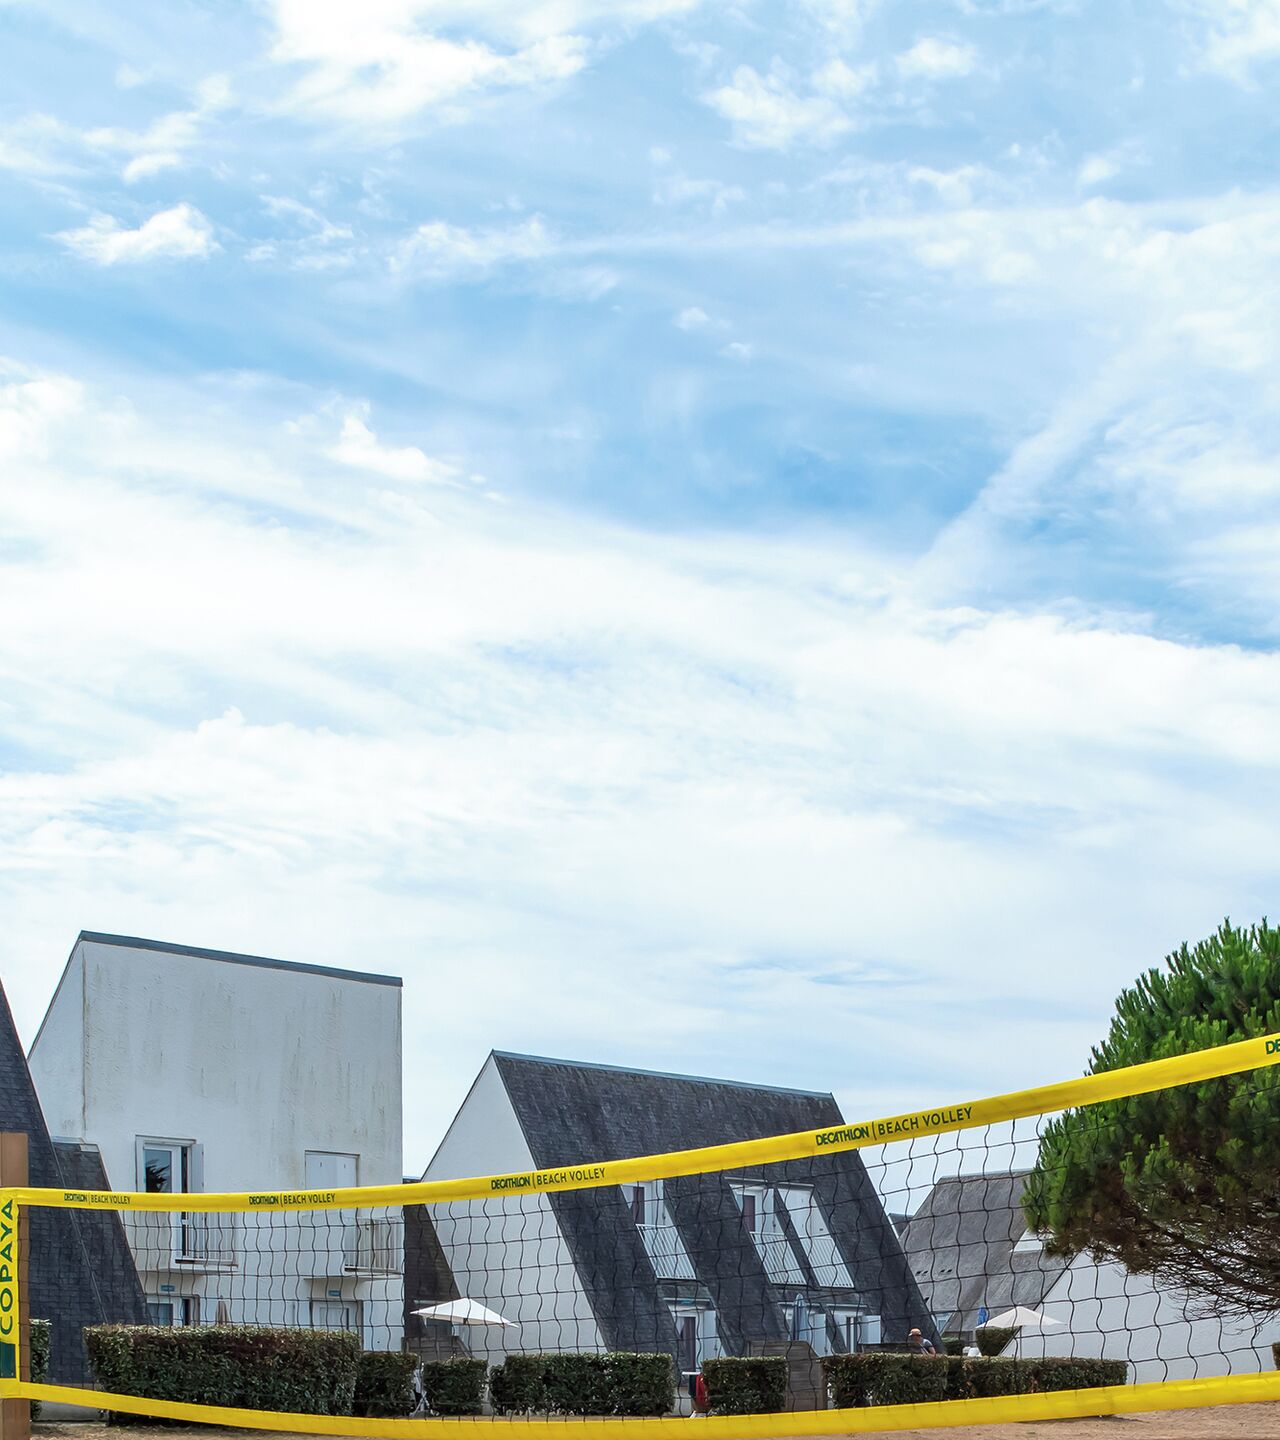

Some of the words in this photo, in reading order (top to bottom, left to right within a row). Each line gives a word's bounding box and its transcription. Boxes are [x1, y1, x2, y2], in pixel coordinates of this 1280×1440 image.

[815, 1126, 870, 1146] DECATHLON
[878, 1117, 920, 1136] BEACH
[922, 1107, 973, 1127] VOLLEY
[491, 1176, 531, 1190] DECATHLON
[537, 1172, 567, 1185] BEACH
[569, 1168, 606, 1181] VOLLEY
[91, 1194, 109, 1203] BEACH
[110, 1195, 130, 1205] VOLLEY
[284, 1194, 307, 1205] BEACH
[308, 1193, 336, 1203] VOLLEY
[0, 1199, 13, 1336] COPAYA
